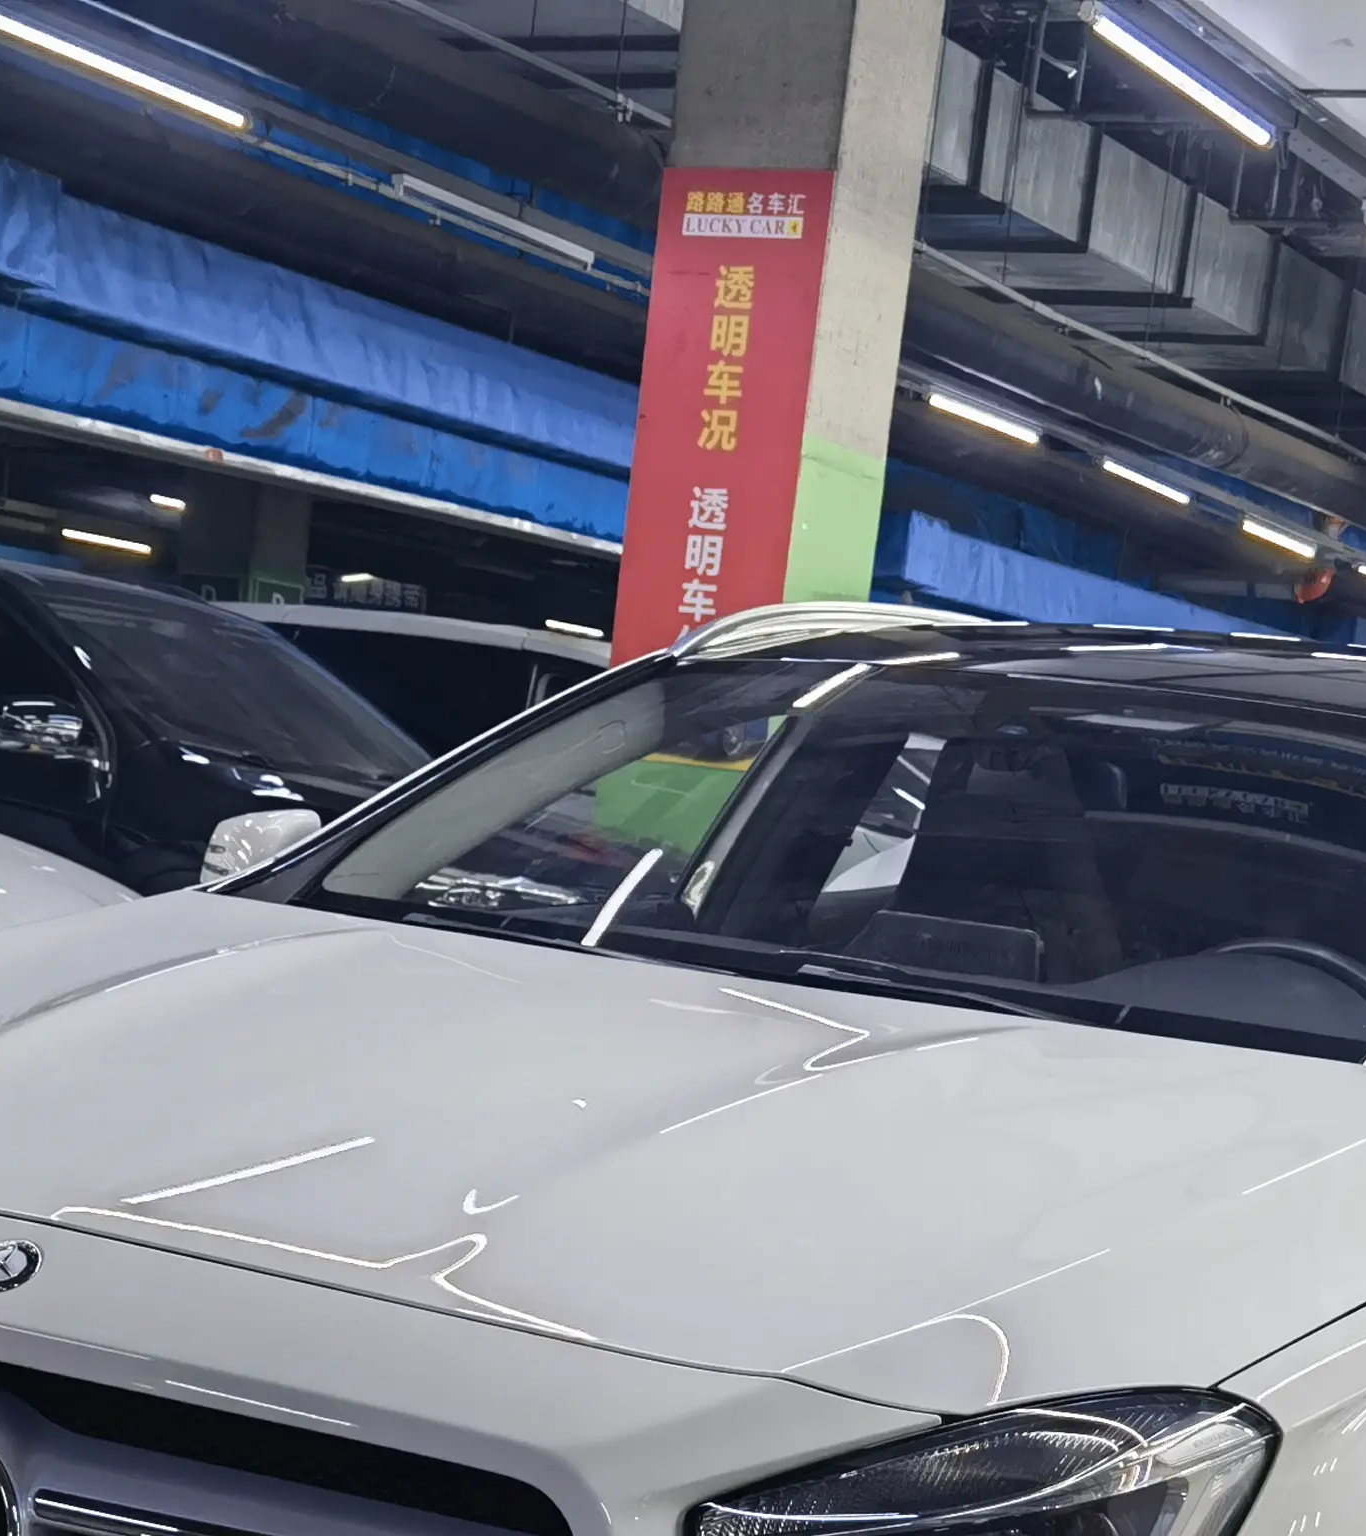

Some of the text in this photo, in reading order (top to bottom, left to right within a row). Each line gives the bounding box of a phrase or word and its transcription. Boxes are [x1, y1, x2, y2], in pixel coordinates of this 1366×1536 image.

[685, 191, 806, 215] 路路通名车汇
[685, 217, 785, 235] LUCKY CAR
[676, 264, 755, 640] 透明车况 透明车
